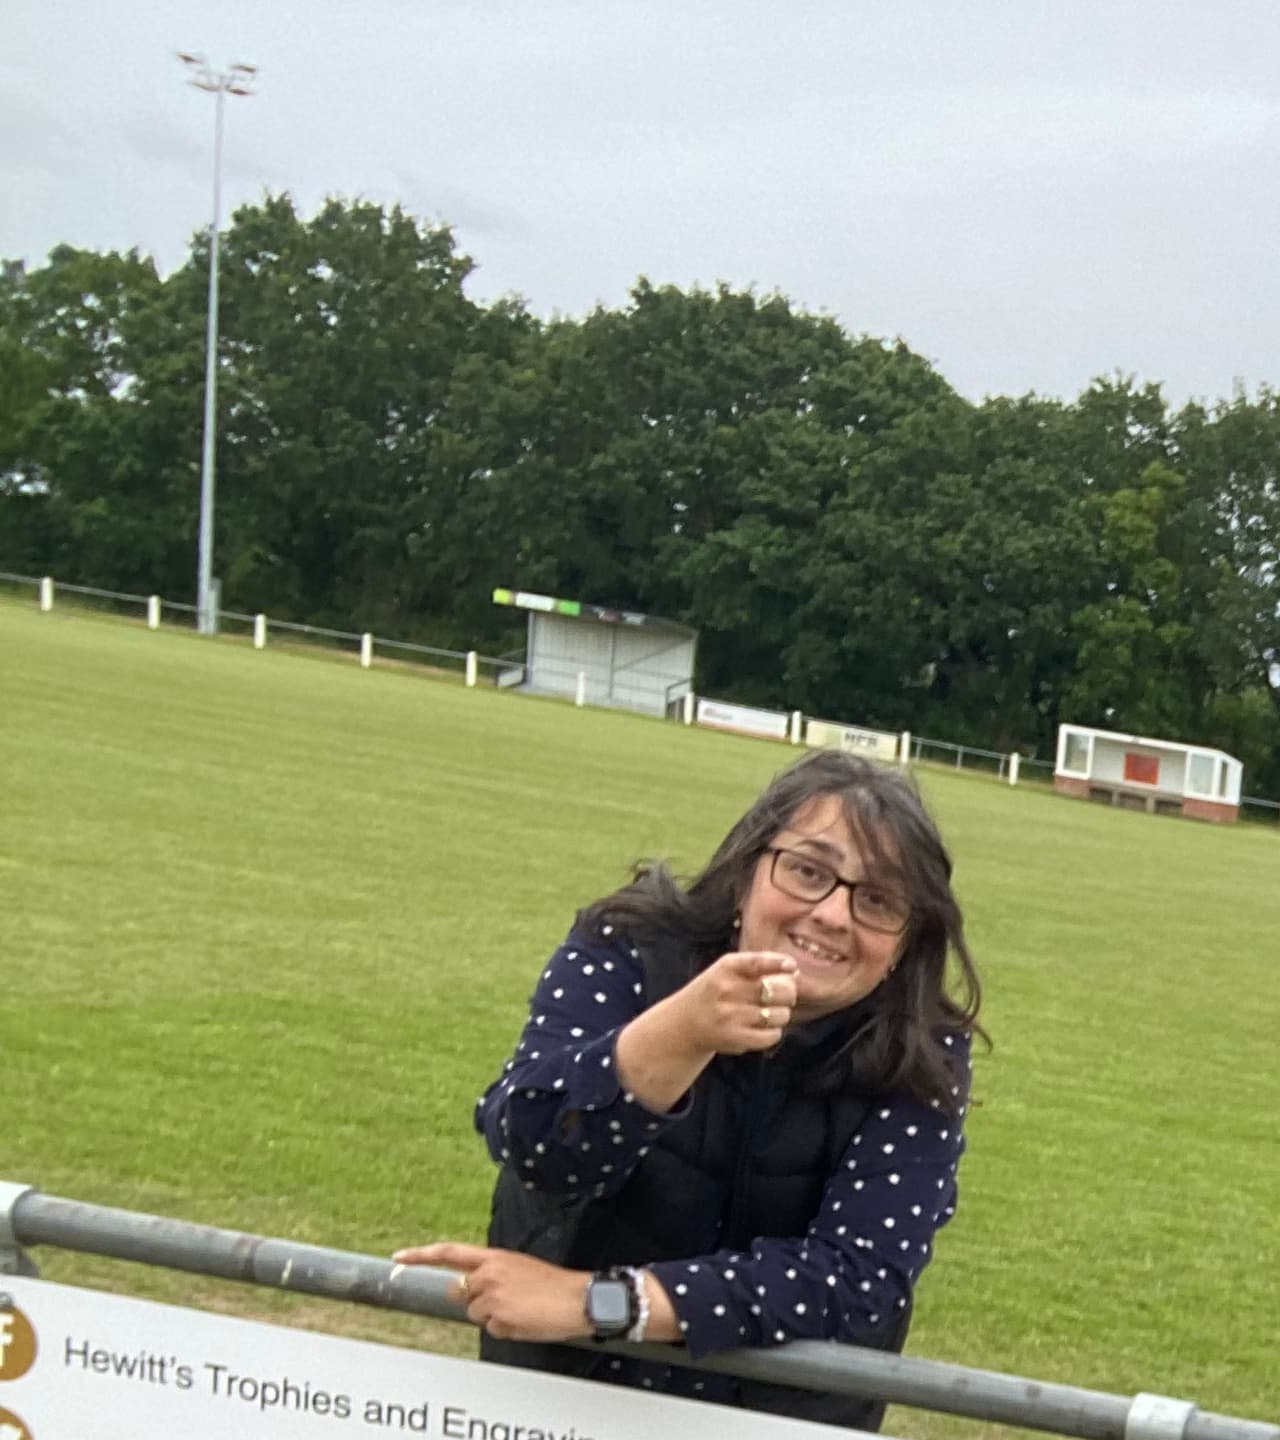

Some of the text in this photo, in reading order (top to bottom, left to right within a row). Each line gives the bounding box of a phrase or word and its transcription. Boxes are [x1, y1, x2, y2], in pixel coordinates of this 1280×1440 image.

[64, 1336, 194, 1390] Hewitt's
[204, 1363, 352, 1419] Trophies
[363, 1401, 429, 1432] and
